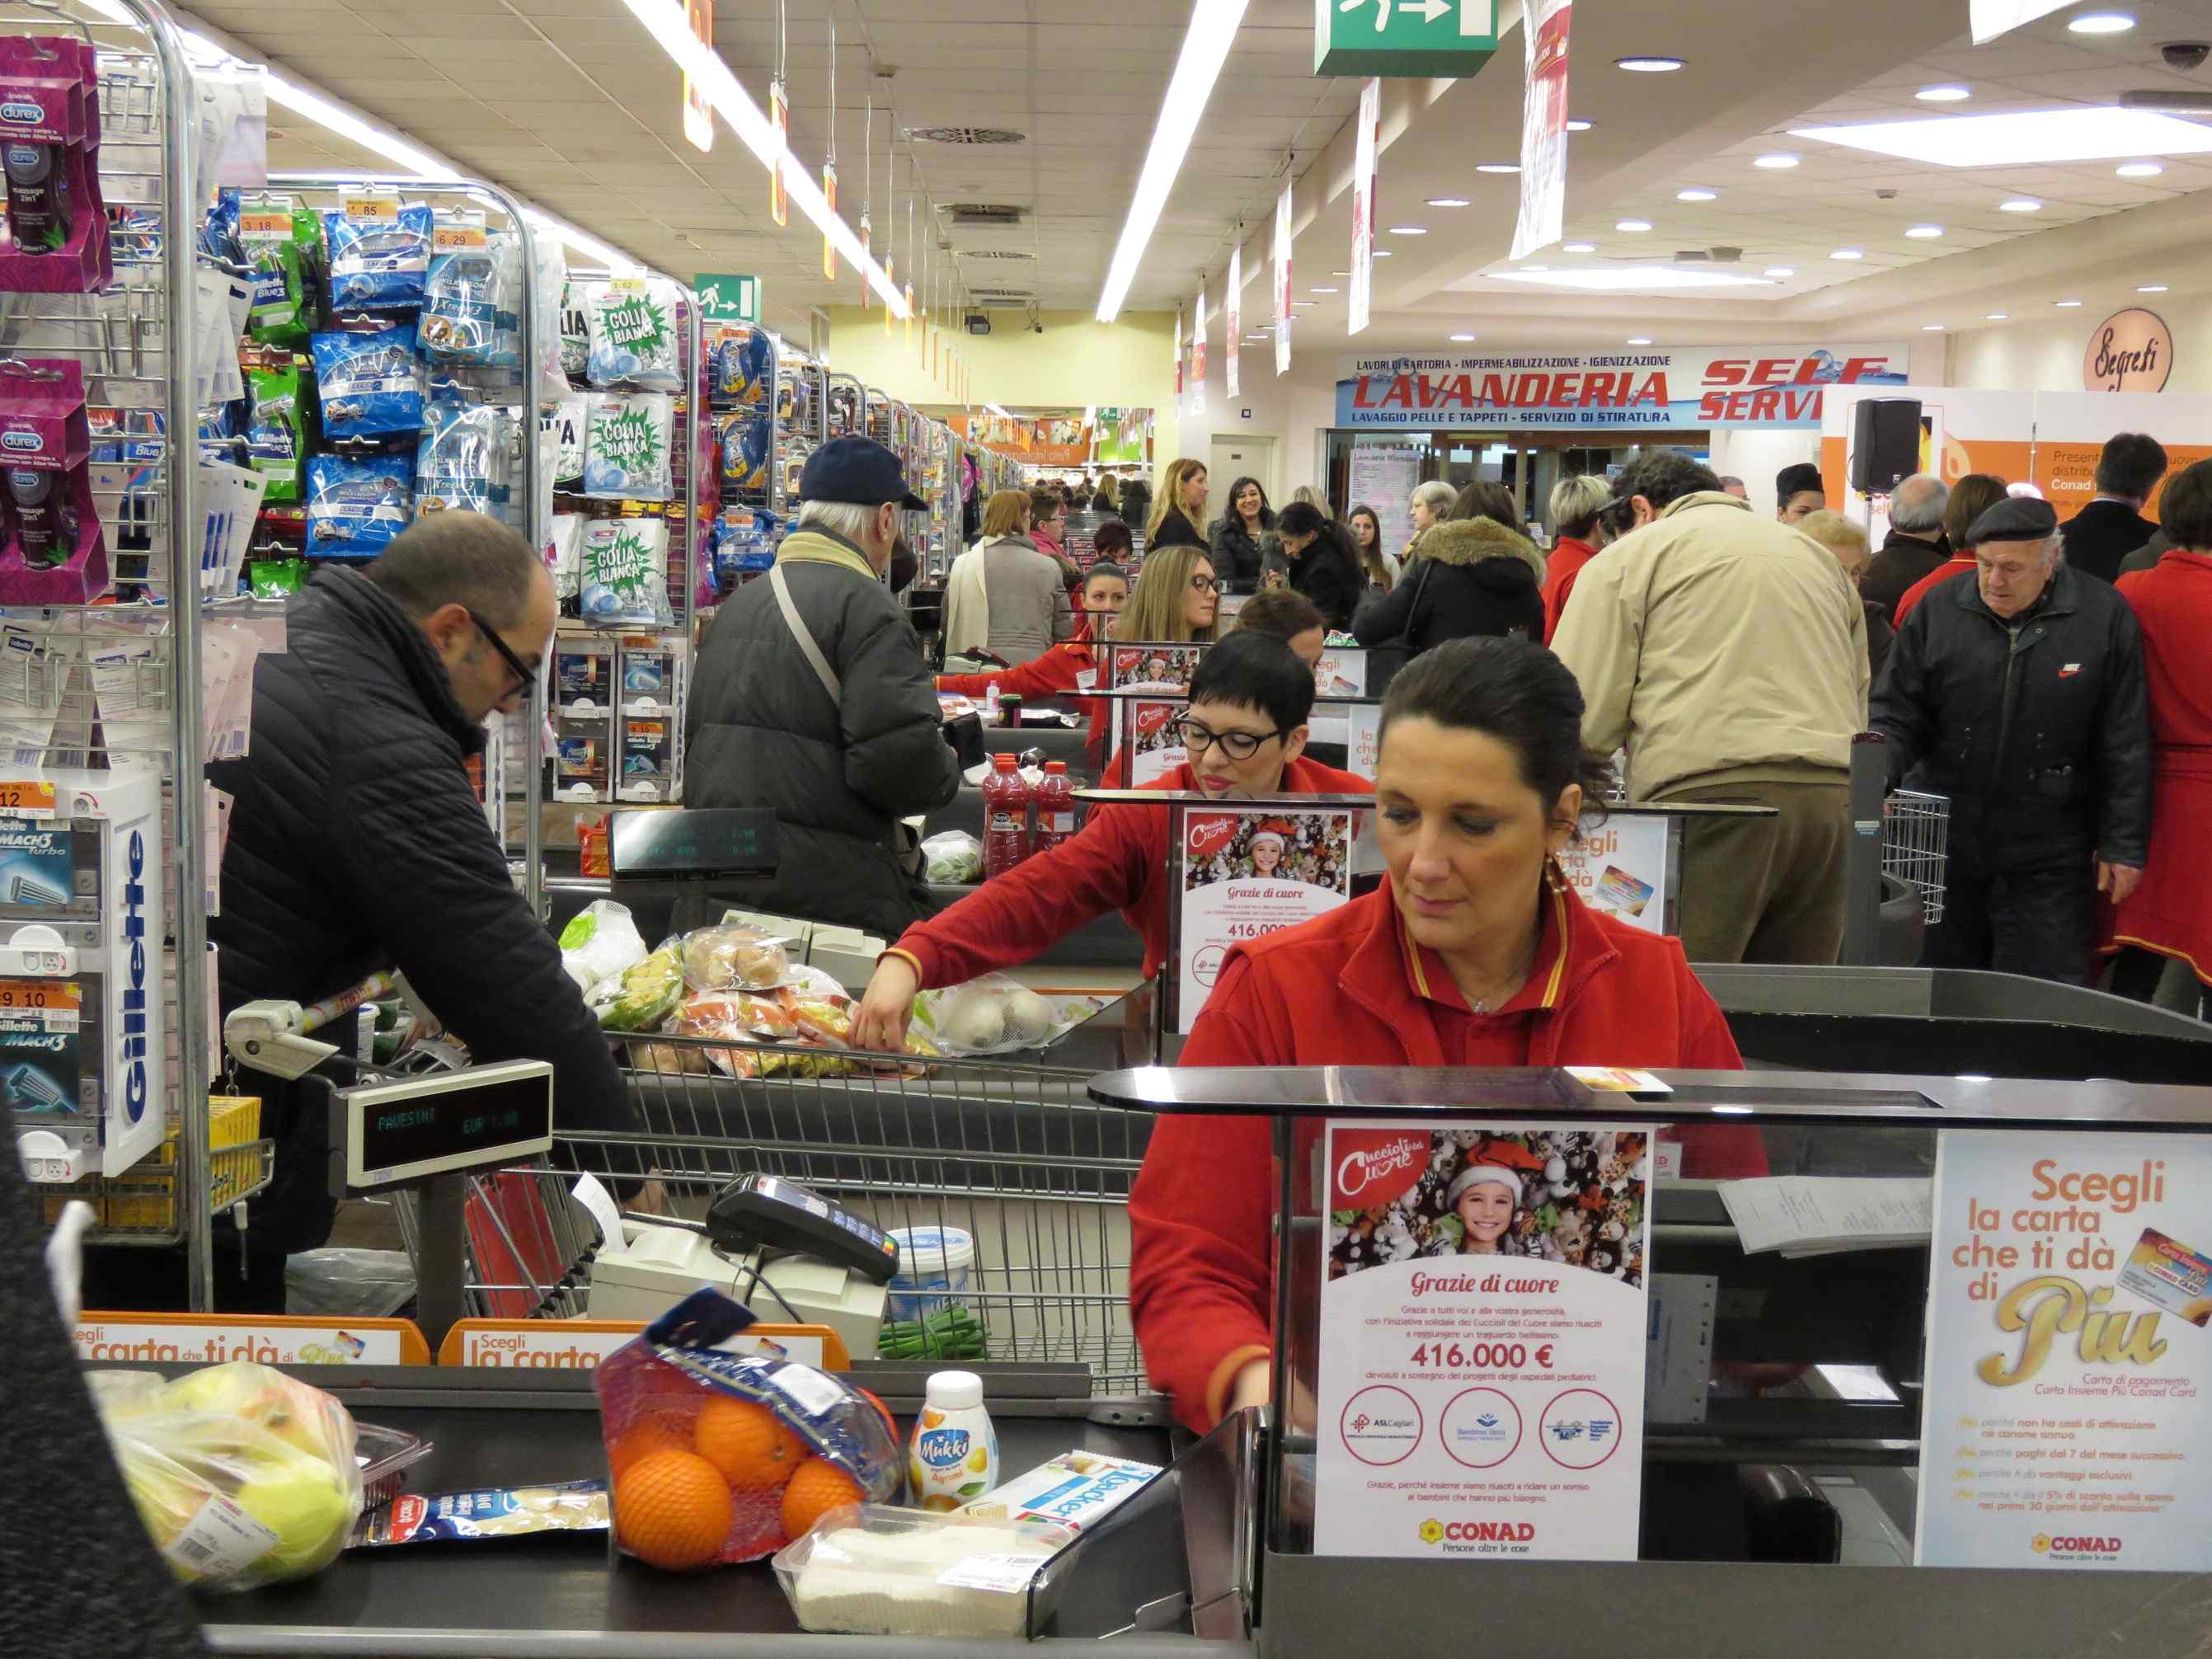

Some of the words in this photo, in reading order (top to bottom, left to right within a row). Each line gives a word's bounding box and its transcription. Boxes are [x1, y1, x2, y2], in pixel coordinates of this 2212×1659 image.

[3, 107, 40, 120] durex
[609, 307, 652, 329] GOLIA
[613, 323, 658, 345] BIANCA
[1357, 360, 1392, 370] LAVORI
[1403, 359, 1452, 370] SARTORIA
[1461, 356, 1580, 369] IMPERMEABILIZZAZIONE
[1590, 355, 1671, 367] IGIENIZZAZIONE
[1701, 357, 1888, 386] SELF
[1353, 371, 1670, 409] LAVANDERIA
[1351, 412, 1407, 423] LAVAGGIO
[1411, 412, 1444, 423] PELLE
[1448, 413, 1455, 422] E
[1458, 412, 1508, 423] TAPPETI
[1520, 412, 1576, 423] SERVIZIO
[1580, 412, 1594, 423] DI
[1598, 411, 1671, 423] STIRATURA
[603, 421, 646, 442] GOLIA
[5, 435, 40, 448] durex
[606, 439, 650, 458] BIANCA
[2053, 451, 2100, 463] Present
[2051, 478, 2092, 491] Conad
[597, 546, 638, 569] GOLIA
[599, 563, 641, 584] BIANCA
[0, 833, 53, 848] MACH3
[28, 846, 66, 856] Turbo
[1228, 886, 1261, 900] Grazie
[1263, 886, 1275, 899] di
[1275, 889, 1304, 900] cuore
[124, 830, 147, 1124] Gillette
[7, 1034, 67, 1052] MACH3
[2031, 1158, 2166, 1214] Scegli
[1968, 1197, 2001, 1232] la
[2012, 1205, 2102, 1234] carta
[1951, 1234, 2019, 1269] che
[2031, 1236, 2055, 1269] ti
[2066, 1237, 2116, 1271] dà
[1411, 1271, 1476, 1297] Grazie
[1481, 1273, 1500, 1293] di
[1505, 1280, 1560, 1294] cuore
[1967, 1271, 1999, 1301] di
[1402, 1305, 1427, 1315] Grazie
[1437, 1306, 1454, 1315] tutti
[1524, 1319, 1547, 1328] Cuore
[92, 1337, 179, 1362] carta
[182, 1348, 203, 1361] che
[204, 1335, 226, 1363] ti
[232, 1335, 279, 1364] dà
[283, 1351, 294, 1363] di
[481, 1334, 527, 1351] Scegli
[471, 1339, 501, 1367] la
[513, 1345, 602, 1369] carta
[1410, 1343, 1527, 1368] 416.000
[1535, 1344, 1554, 1369] €
[2083, 1373, 2112, 1385] Carta
[2116, 1373, 2126, 1385] di
[2128, 1375, 2191, 1388] pagamento
[2035, 1384, 2065, 1396] Carta
[2068, 1385, 2109, 1397] Insieme
[2130, 1386, 2167, 1398] Conad
[2169, 1386, 2197, 1398] Card
[920, 1438, 969, 1463] Mukki
[1444, 1522, 1536, 1542] CONAD
[1442, 1543, 1476, 1553] Persone
[1477, 1544, 1499, 1553] oltre
[1500, 1544, 1508, 1553] le
[1510, 1545, 1530, 1553] cose
[2050, 1536, 2122, 1553] CONAD
